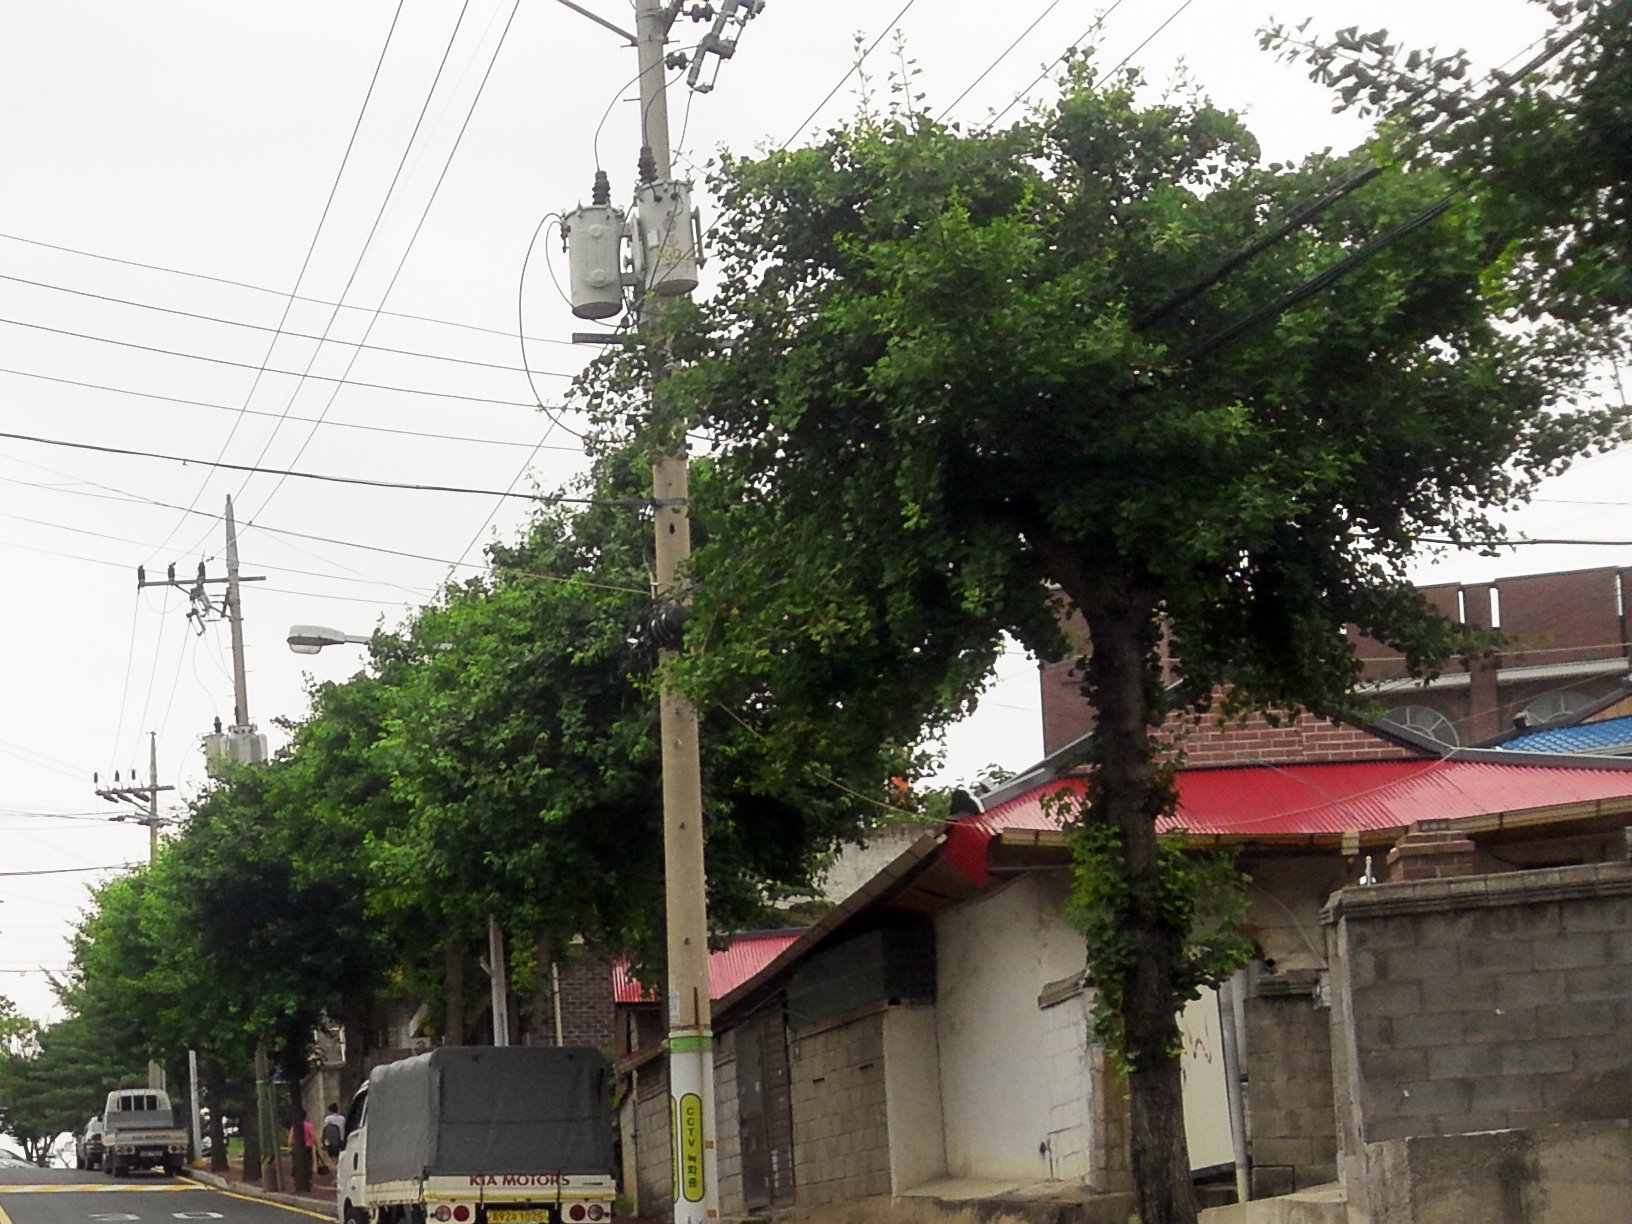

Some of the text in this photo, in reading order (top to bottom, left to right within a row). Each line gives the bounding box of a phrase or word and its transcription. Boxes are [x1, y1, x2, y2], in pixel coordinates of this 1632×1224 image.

[686, 1106, 695, 1147] CCTV
[469, 1174, 570, 1186] KIA MOTORS
